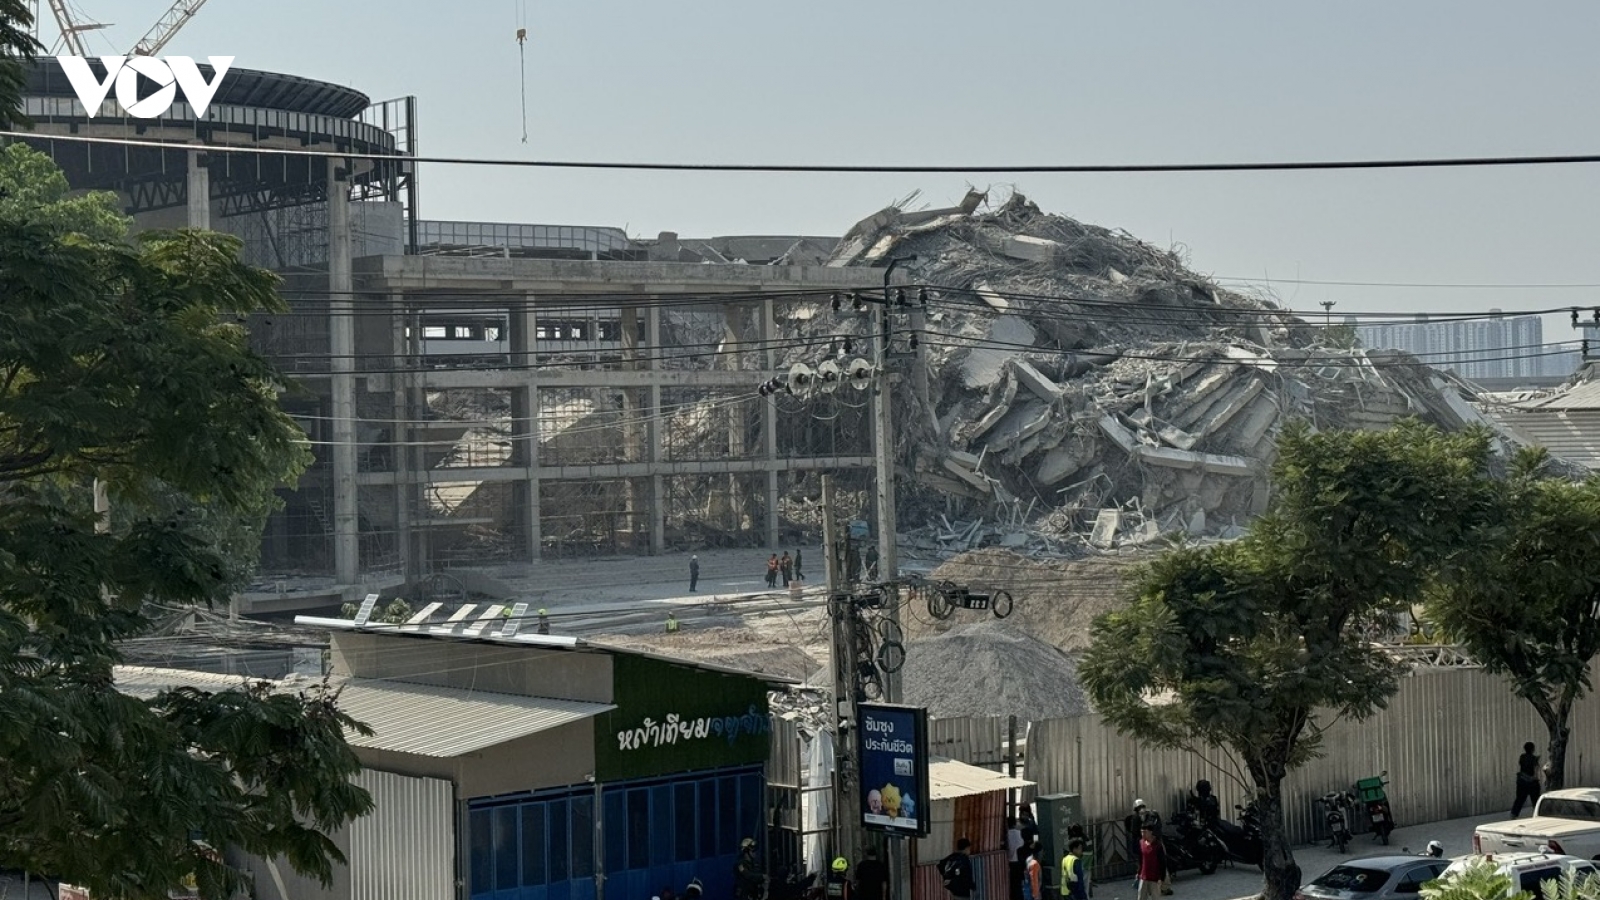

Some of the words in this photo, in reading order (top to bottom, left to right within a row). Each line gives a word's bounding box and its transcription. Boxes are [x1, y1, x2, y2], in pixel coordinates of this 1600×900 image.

[865, 738, 913, 754] ประกันชีวิต
